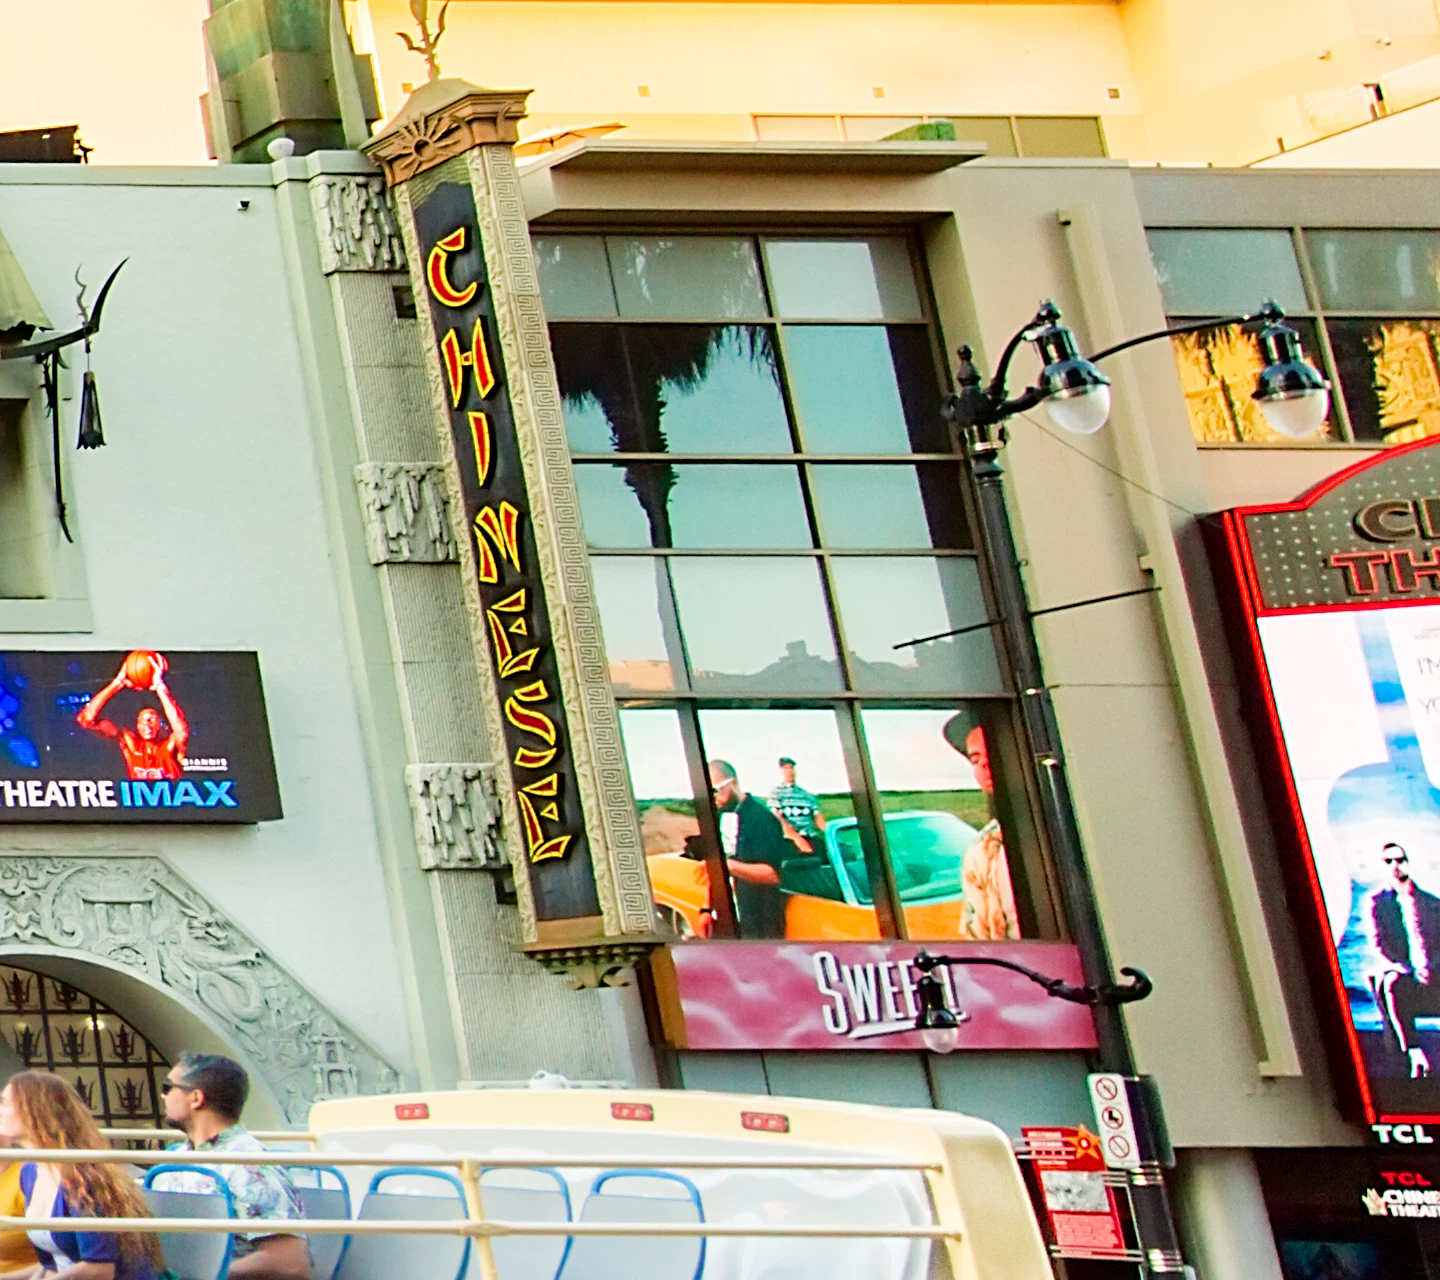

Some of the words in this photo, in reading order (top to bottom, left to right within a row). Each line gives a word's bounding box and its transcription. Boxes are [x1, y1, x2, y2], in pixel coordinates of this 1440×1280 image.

[426, 225, 573, 865] CHINESE
[120, 779, 239, 808] IMAX
[1371, 1124, 1434, 1144] TCL
[1381, 1171, 1432, 1187] TCL
